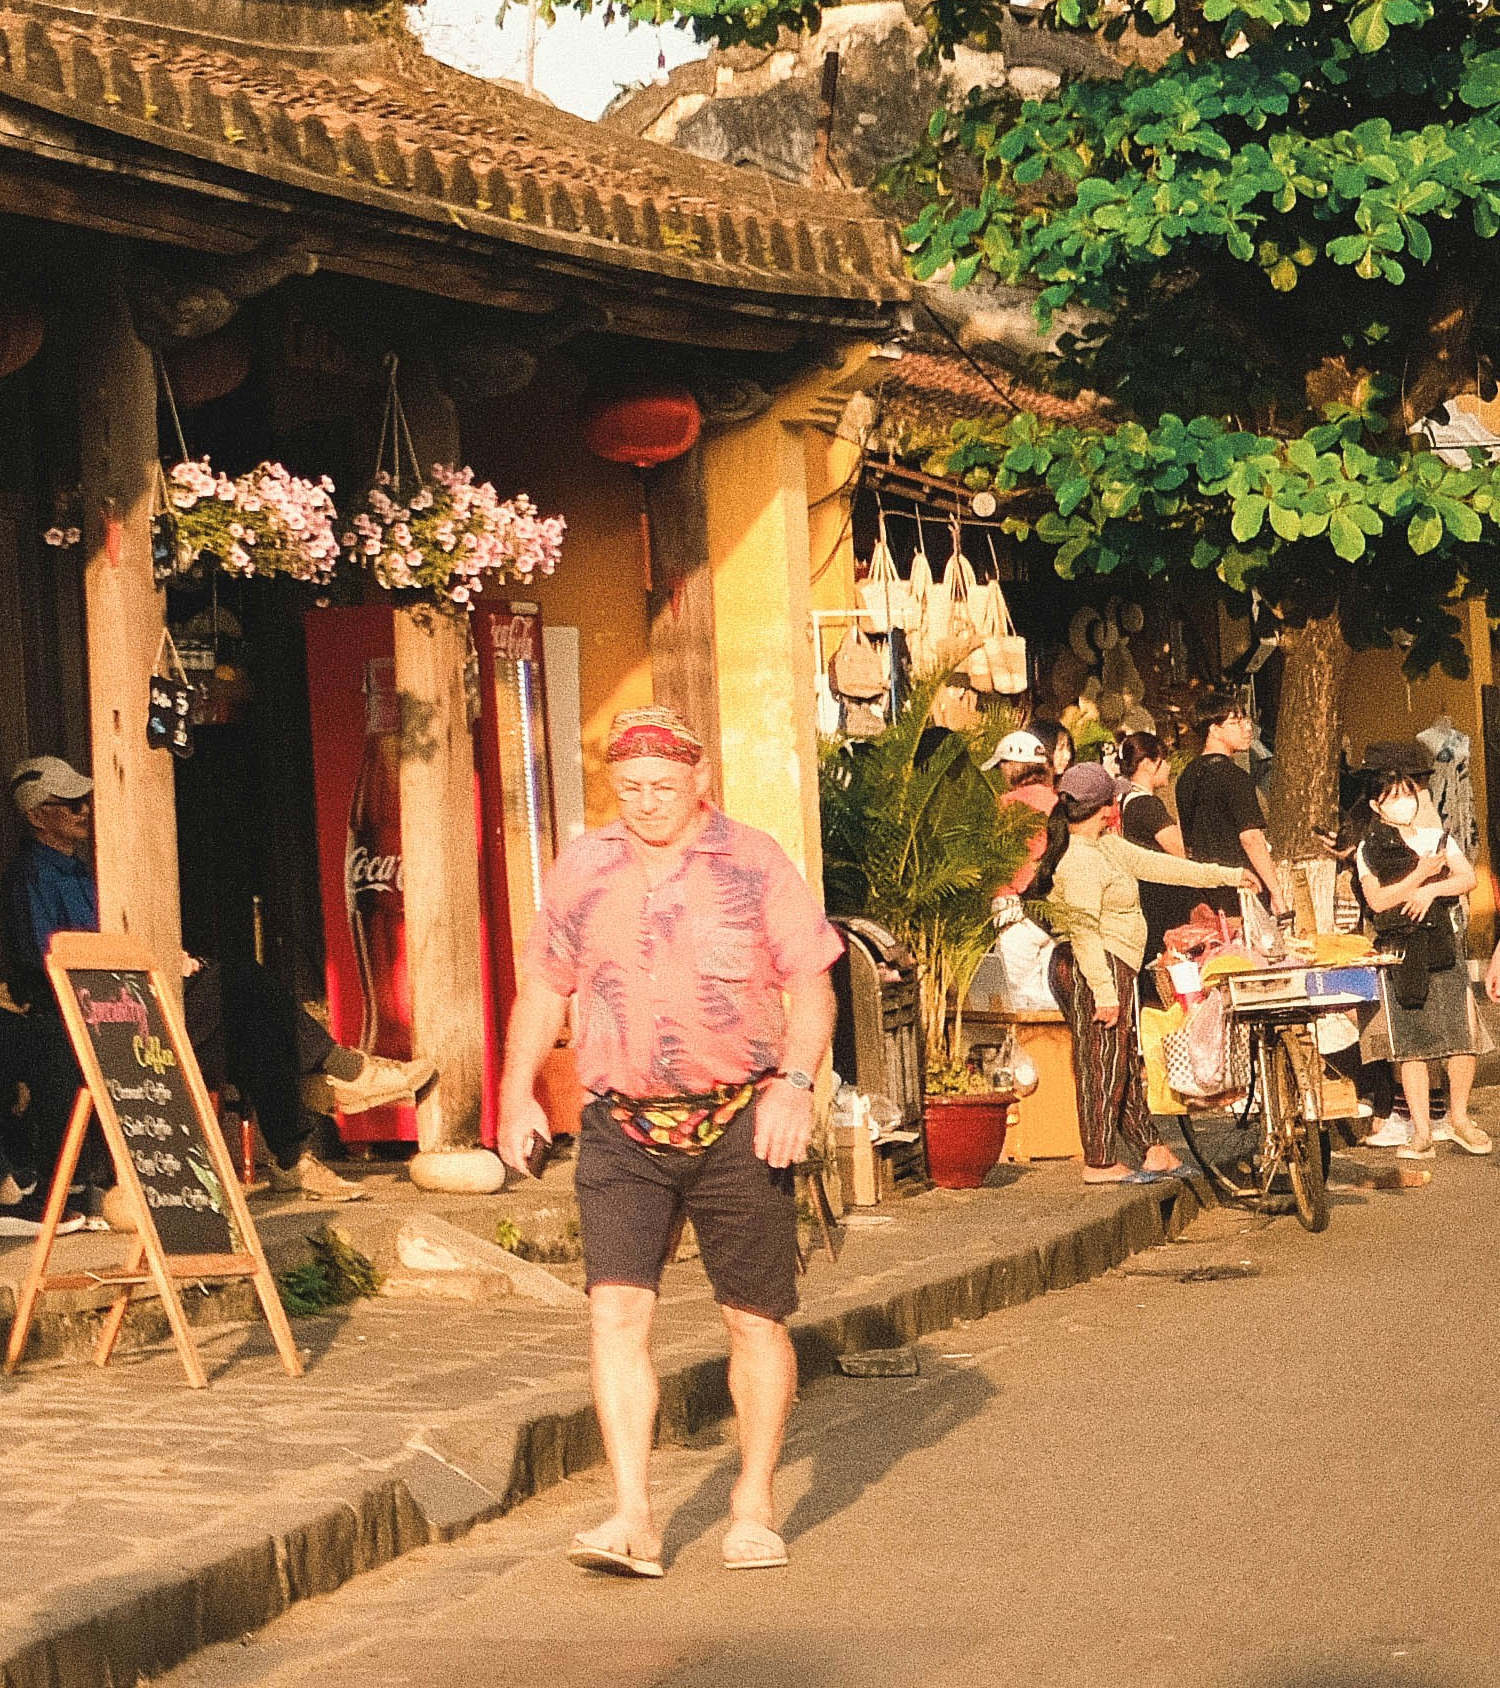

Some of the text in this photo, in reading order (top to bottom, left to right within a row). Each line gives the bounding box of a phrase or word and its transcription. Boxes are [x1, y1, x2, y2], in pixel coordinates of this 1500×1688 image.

[133, 1034, 176, 1075] Coffee
[144, 1078, 173, 1105] Coffee
[145, 1114, 173, 1141] Coffee
[154, 1150, 182, 1177] Coffee
[181, 1185, 210, 1212] Coffee
